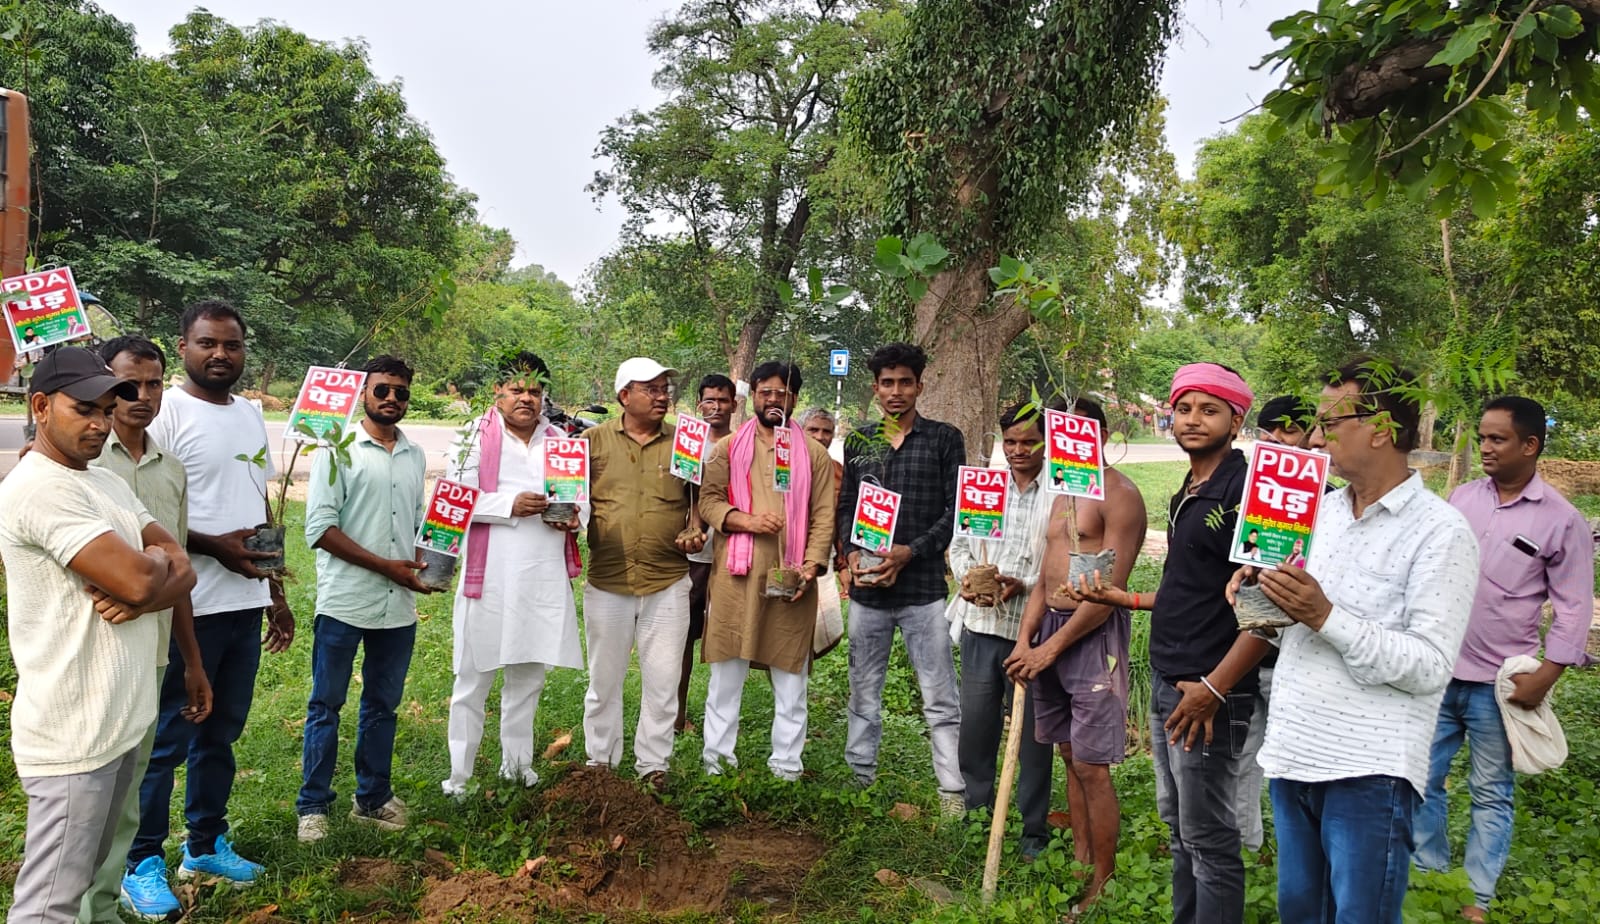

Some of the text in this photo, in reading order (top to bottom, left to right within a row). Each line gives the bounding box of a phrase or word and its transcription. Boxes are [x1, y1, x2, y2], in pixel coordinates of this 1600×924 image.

[4, 272, 67, 293] PDA
[309, 371, 357, 389] PDA
[680, 418, 705, 438] PDA
[1050, 414, 1096, 438] PDA
[547, 440, 585, 454] PDA
[1052, 431, 1095, 460] पेड़
[1256, 449, 1320, 484] PDA
[963, 470, 1005, 487] PDA
[436, 482, 474, 505] PDA
[863, 487, 895, 509] PDA
[1255, 475, 1315, 520] पेड़
